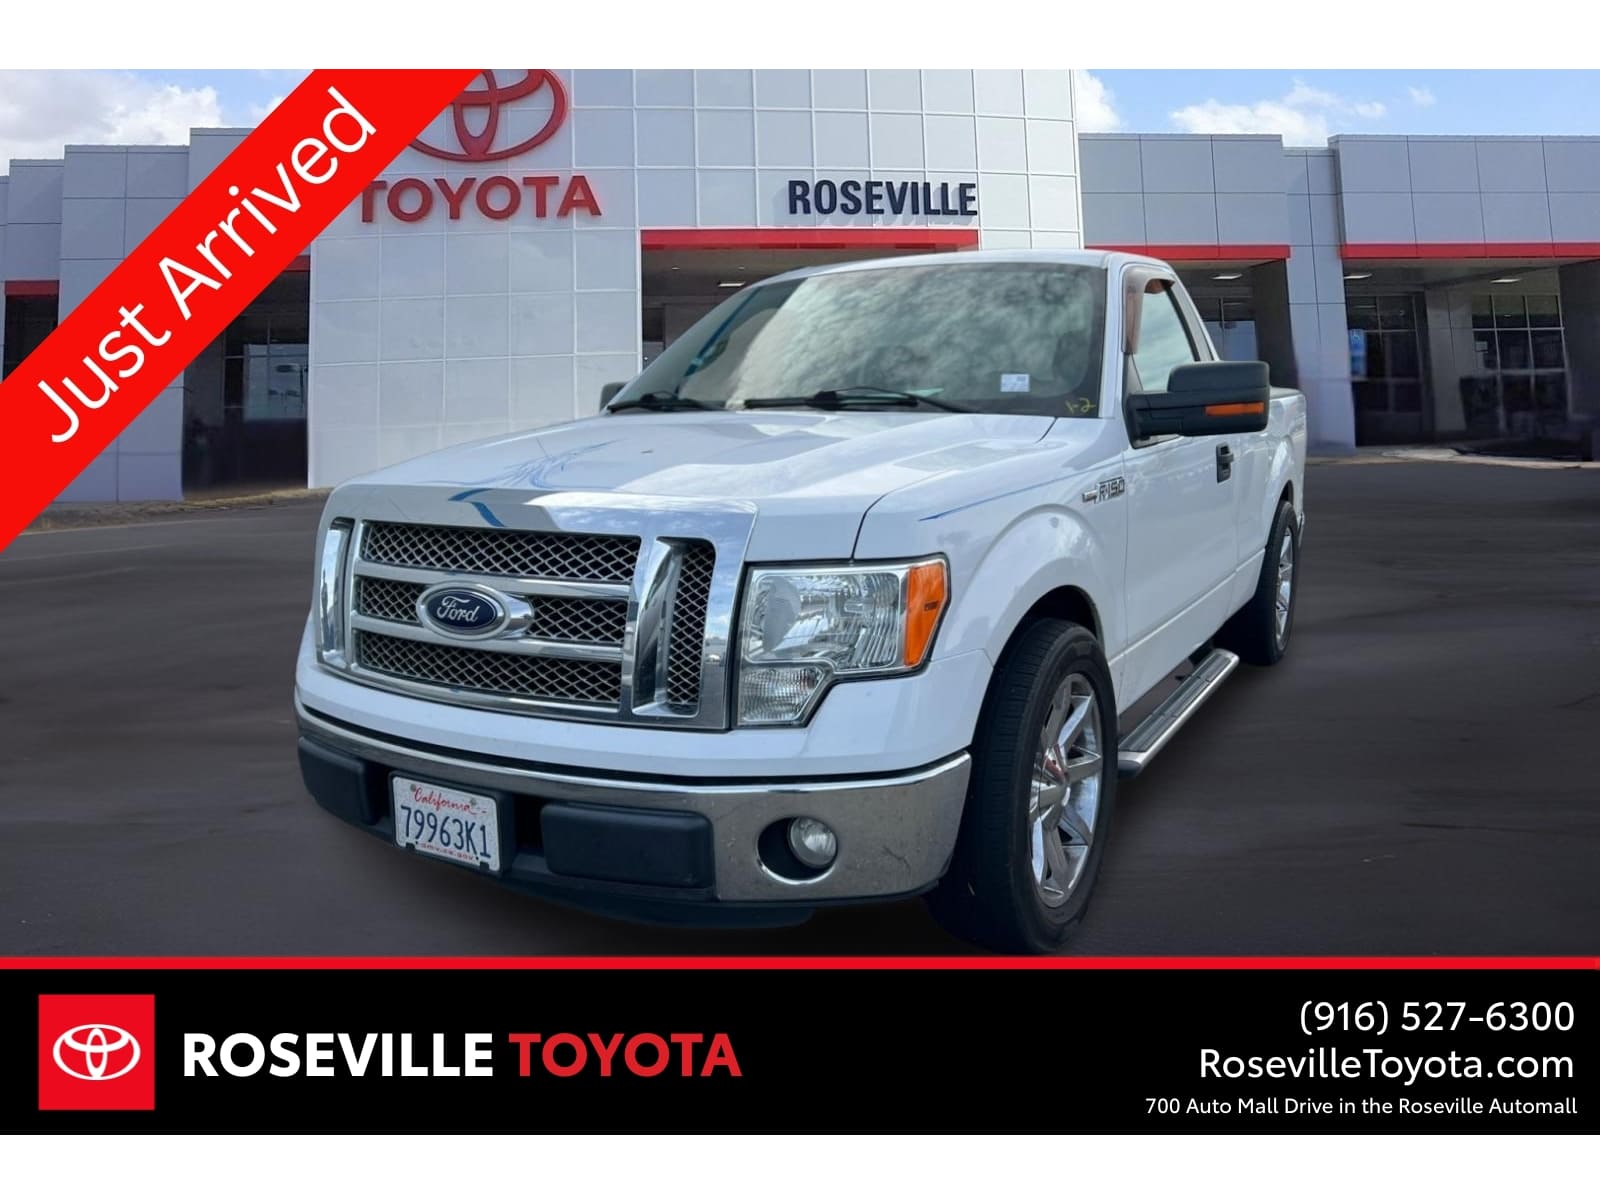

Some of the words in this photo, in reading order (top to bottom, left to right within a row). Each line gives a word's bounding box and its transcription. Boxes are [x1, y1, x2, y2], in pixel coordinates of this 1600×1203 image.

[361, 175, 602, 223] TOYOTA
[788, 179, 978, 216] ROSEVILLE
[436, 595, 481, 623] Ford
[414, 787, 478, 815] California
[400, 804, 492, 859] 79963K1
